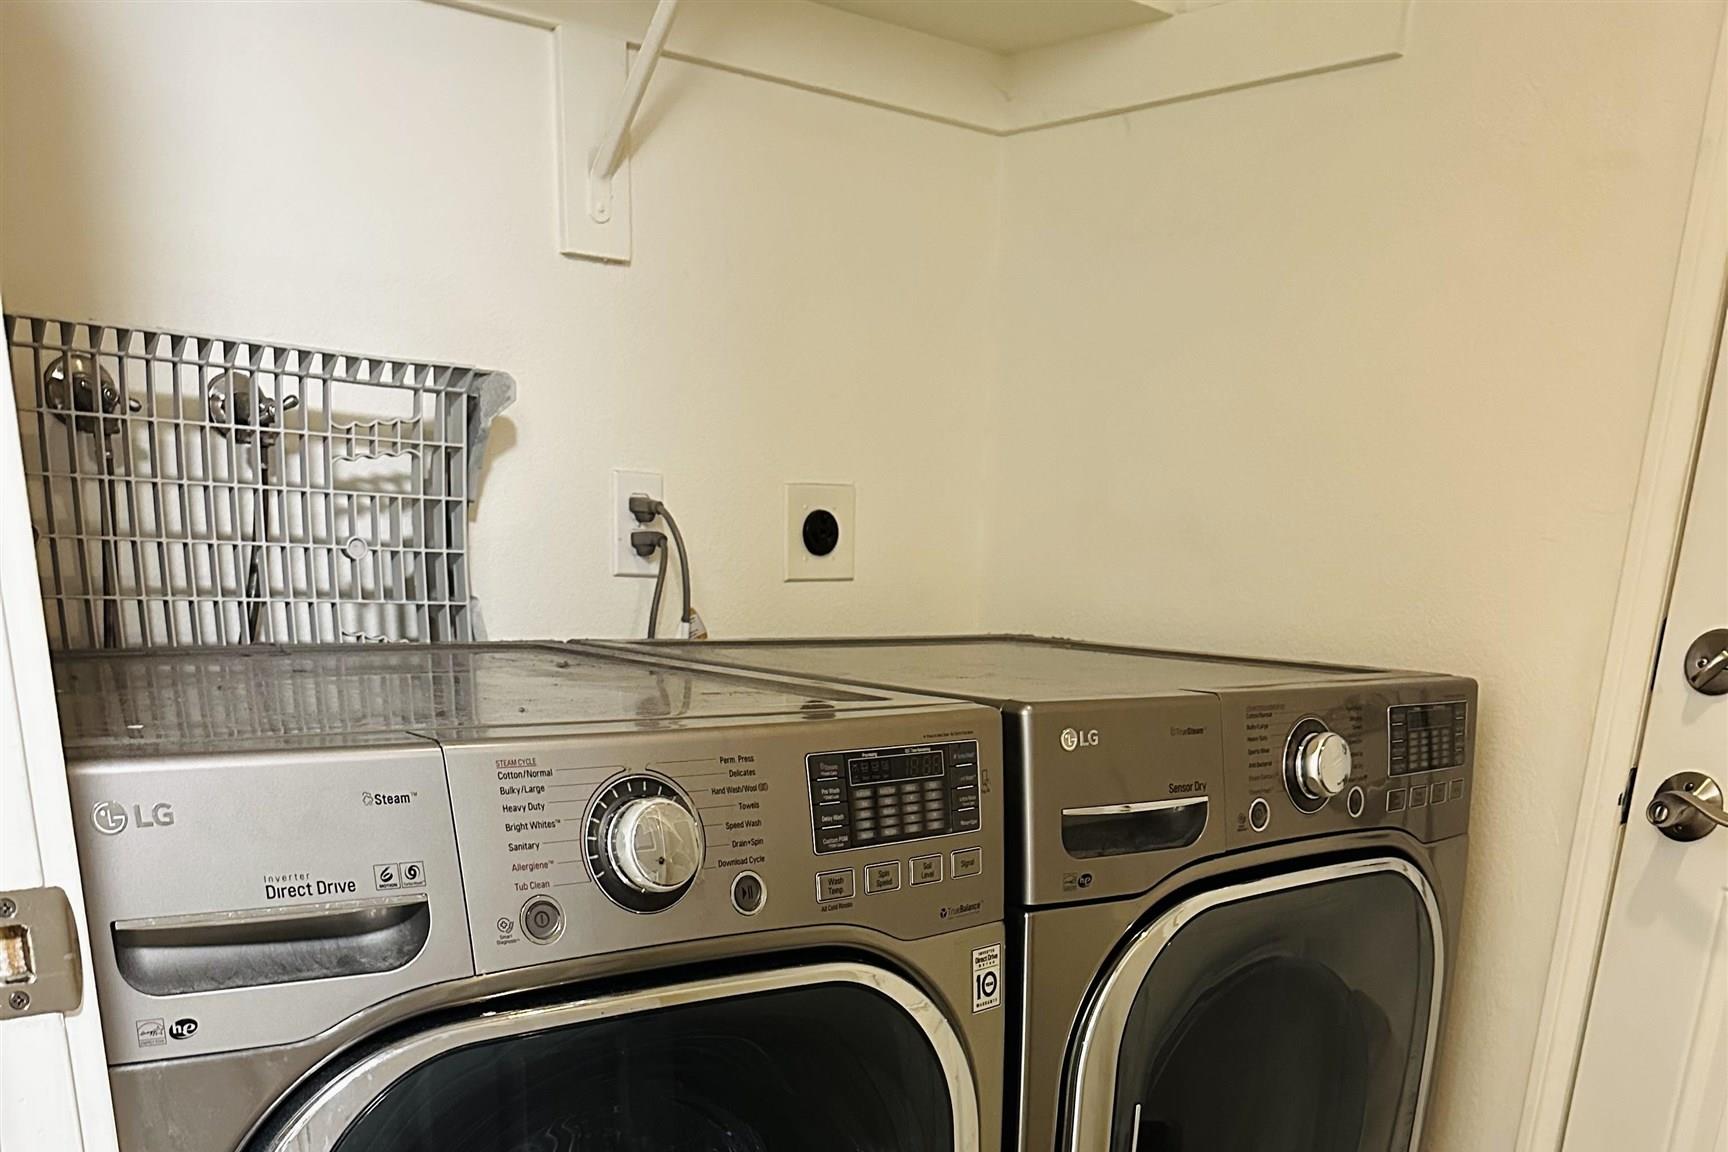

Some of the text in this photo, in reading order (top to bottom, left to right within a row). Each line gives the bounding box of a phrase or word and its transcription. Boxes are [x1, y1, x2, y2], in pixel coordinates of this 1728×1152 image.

[1079, 729, 1099, 746] LG
[496, 757, 536, 768] STEAM CYCLE
[738, 755, 754, 763] Press
[498, 769, 553, 780] Cotton/Normal
[729, 769, 756, 777] Delicates
[500, 784, 545, 796] Bulky/Large
[711, 786, 726, 795] Hand
[1169, 781, 1207, 794] Sensor Dry
[502, 802, 545, 813] Heavy Duty
[739, 802, 760, 810] Towels
[135, 802, 175, 828] LG
[505, 822, 528, 833] Bright
[725, 820, 762, 831] Speed Wash
[508, 841, 540, 852] Sanitary
[718, 856, 765, 868] Download Cycle
[263, 872, 311, 884] Inverter
[828, 876, 844, 885] Wash
[265, 880, 356, 900] Direct Drive
[514, 880, 550, 892] Tub Clean
[828, 886, 844, 896] Temp
[976, 971, 997, 1000] 10
